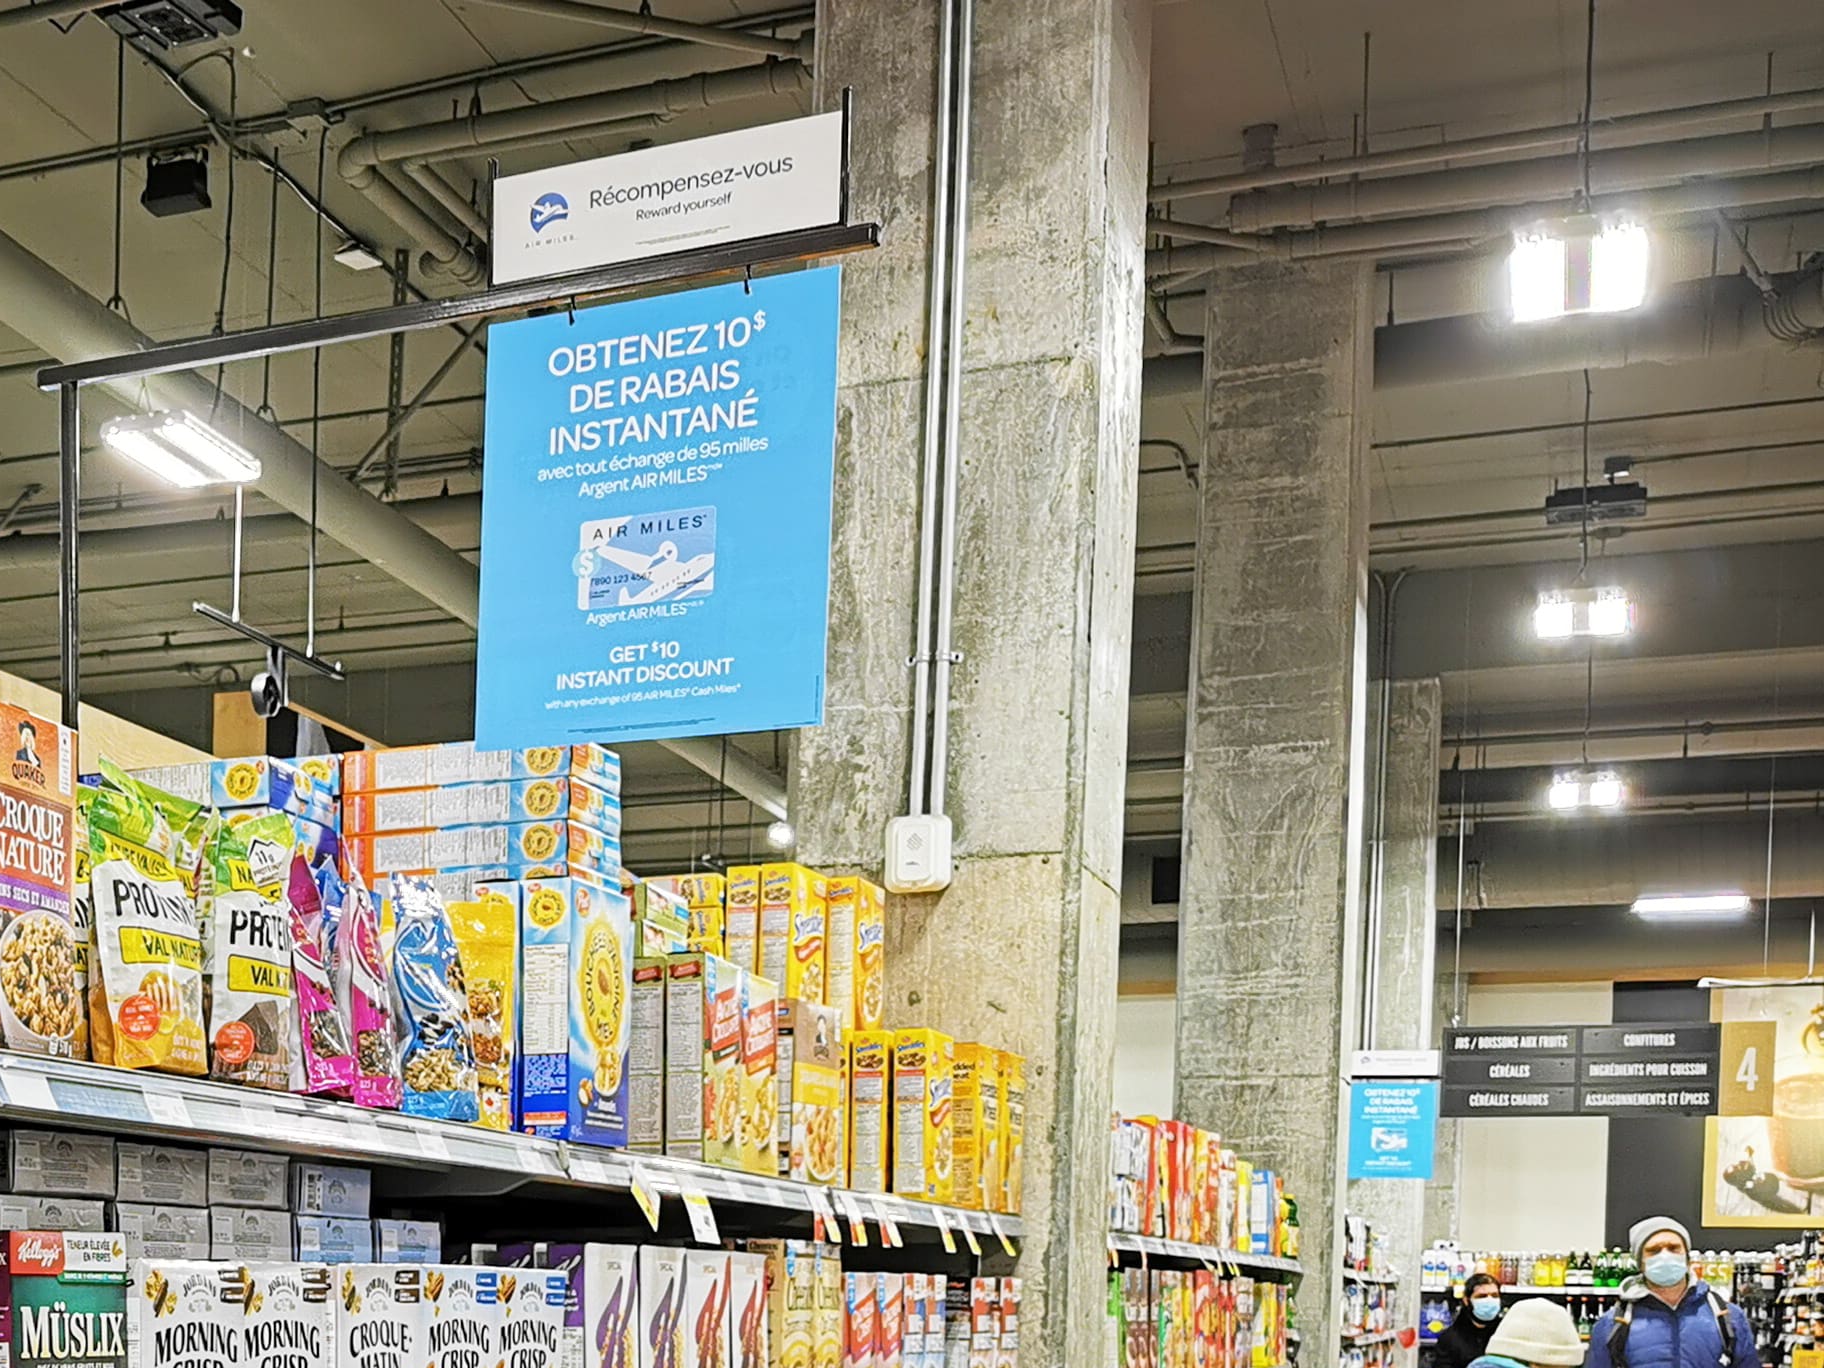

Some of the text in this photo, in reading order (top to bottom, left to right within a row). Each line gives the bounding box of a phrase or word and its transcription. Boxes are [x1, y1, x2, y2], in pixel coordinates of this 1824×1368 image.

[589, 155, 794, 209] Récompensez-vous
[636, 192, 732, 220] Reward yourself
[549, 322, 708, 378] OBTENEZ
[570, 360, 740, 413] DE RABAIS
[550, 389, 758, 456] INSTANTANÉ
[537, 435, 768, 482] avec tout échange de 95 milles
[578, 479, 629, 500] Argent
[631, 475, 657, 491] AIR
[592, 515, 703, 541] AIR MILES
[609, 640, 680, 664] GET $10
[556, 657, 734, 691] INSTANT DISCOUNT
[1538, 1034, 1568, 1050] FRUITS
[1623, 1032, 1676, 1048] CONFITURES
[1489, 1062, 1530, 1079] CÉRÉALES
[1588, 1060, 1643, 1077] INGRÉDIENTS
[1668, 1062, 1707, 1076] CUISSON
[1735, 1046, 1759, 1092] 4
[1468, 1090, 1549, 1107] CÉRÉALES CHAUDES
[1585, 1087, 1710, 1107] ASSAISONNEMENTS ET ÉPICES
[153, 1324, 239, 1368] MORNING
